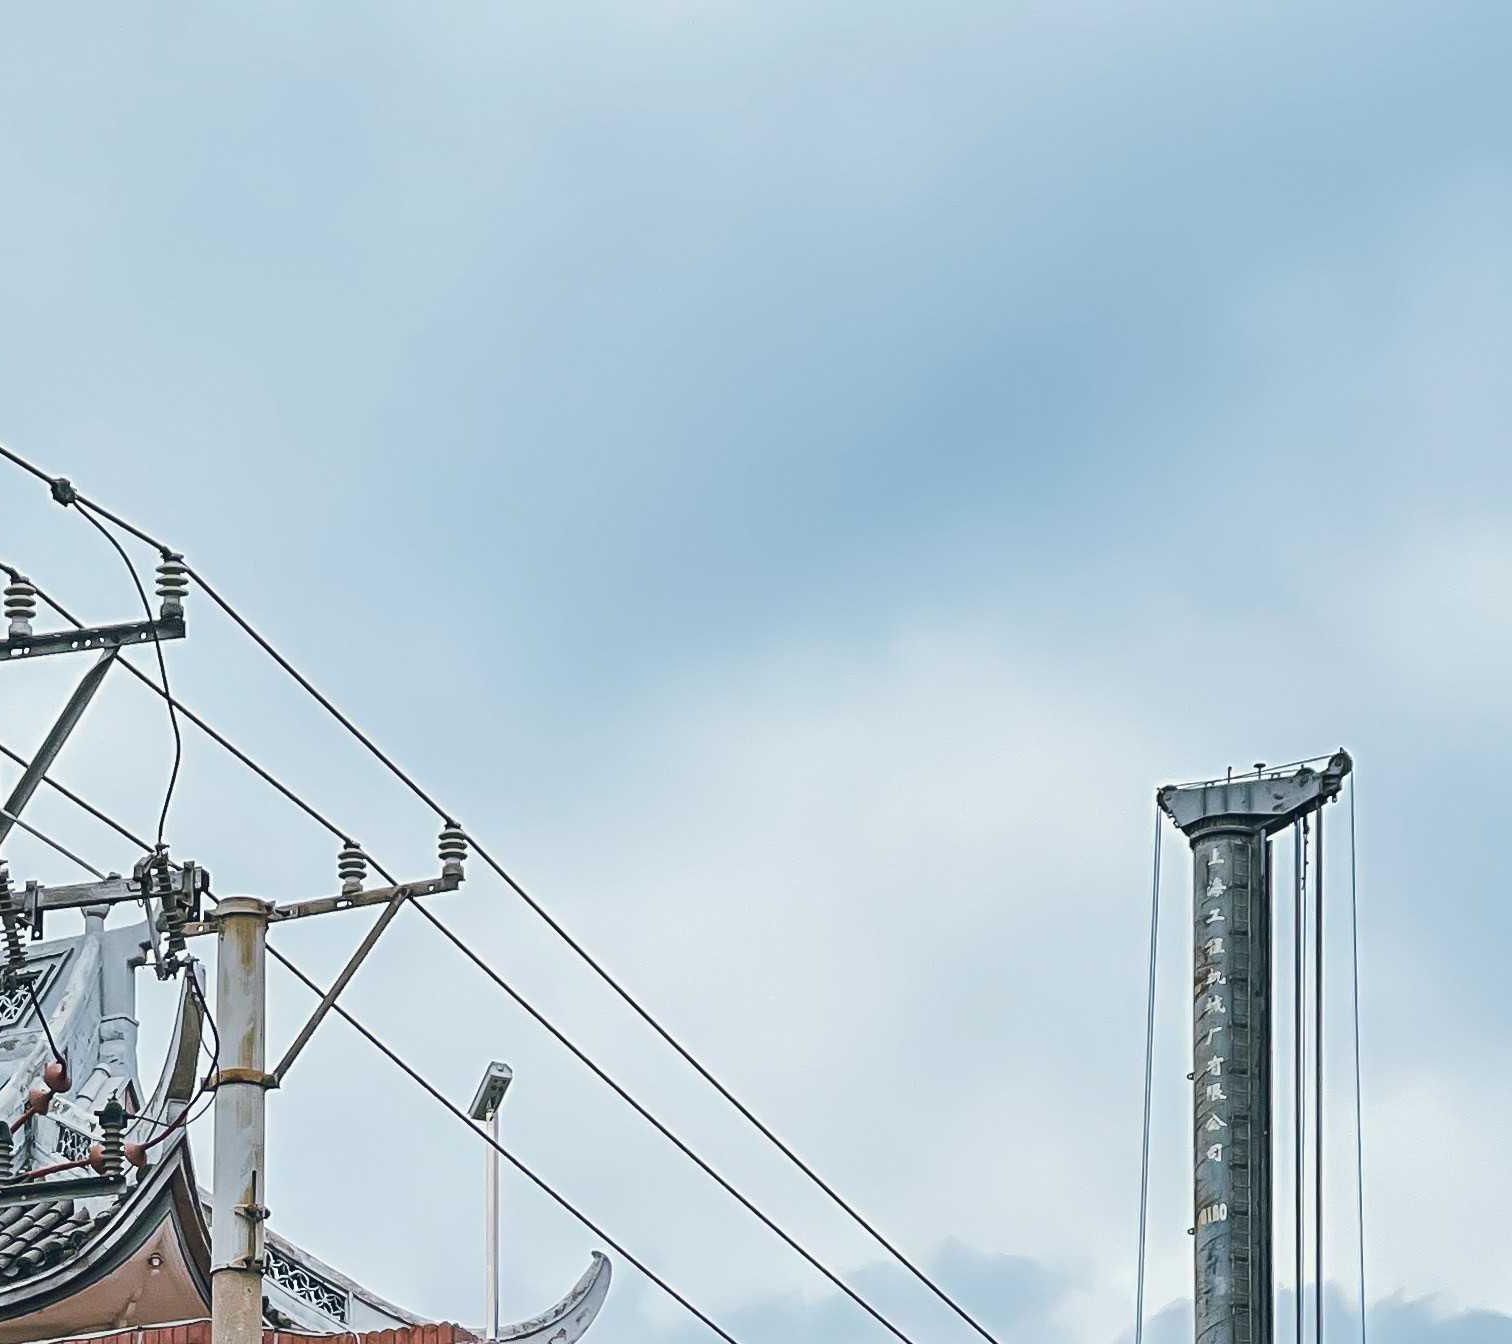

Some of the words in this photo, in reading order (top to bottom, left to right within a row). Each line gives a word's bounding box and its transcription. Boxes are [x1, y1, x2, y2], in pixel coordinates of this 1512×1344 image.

[1205, 847, 1228, 1162] 上海工程机械厂有限公司
